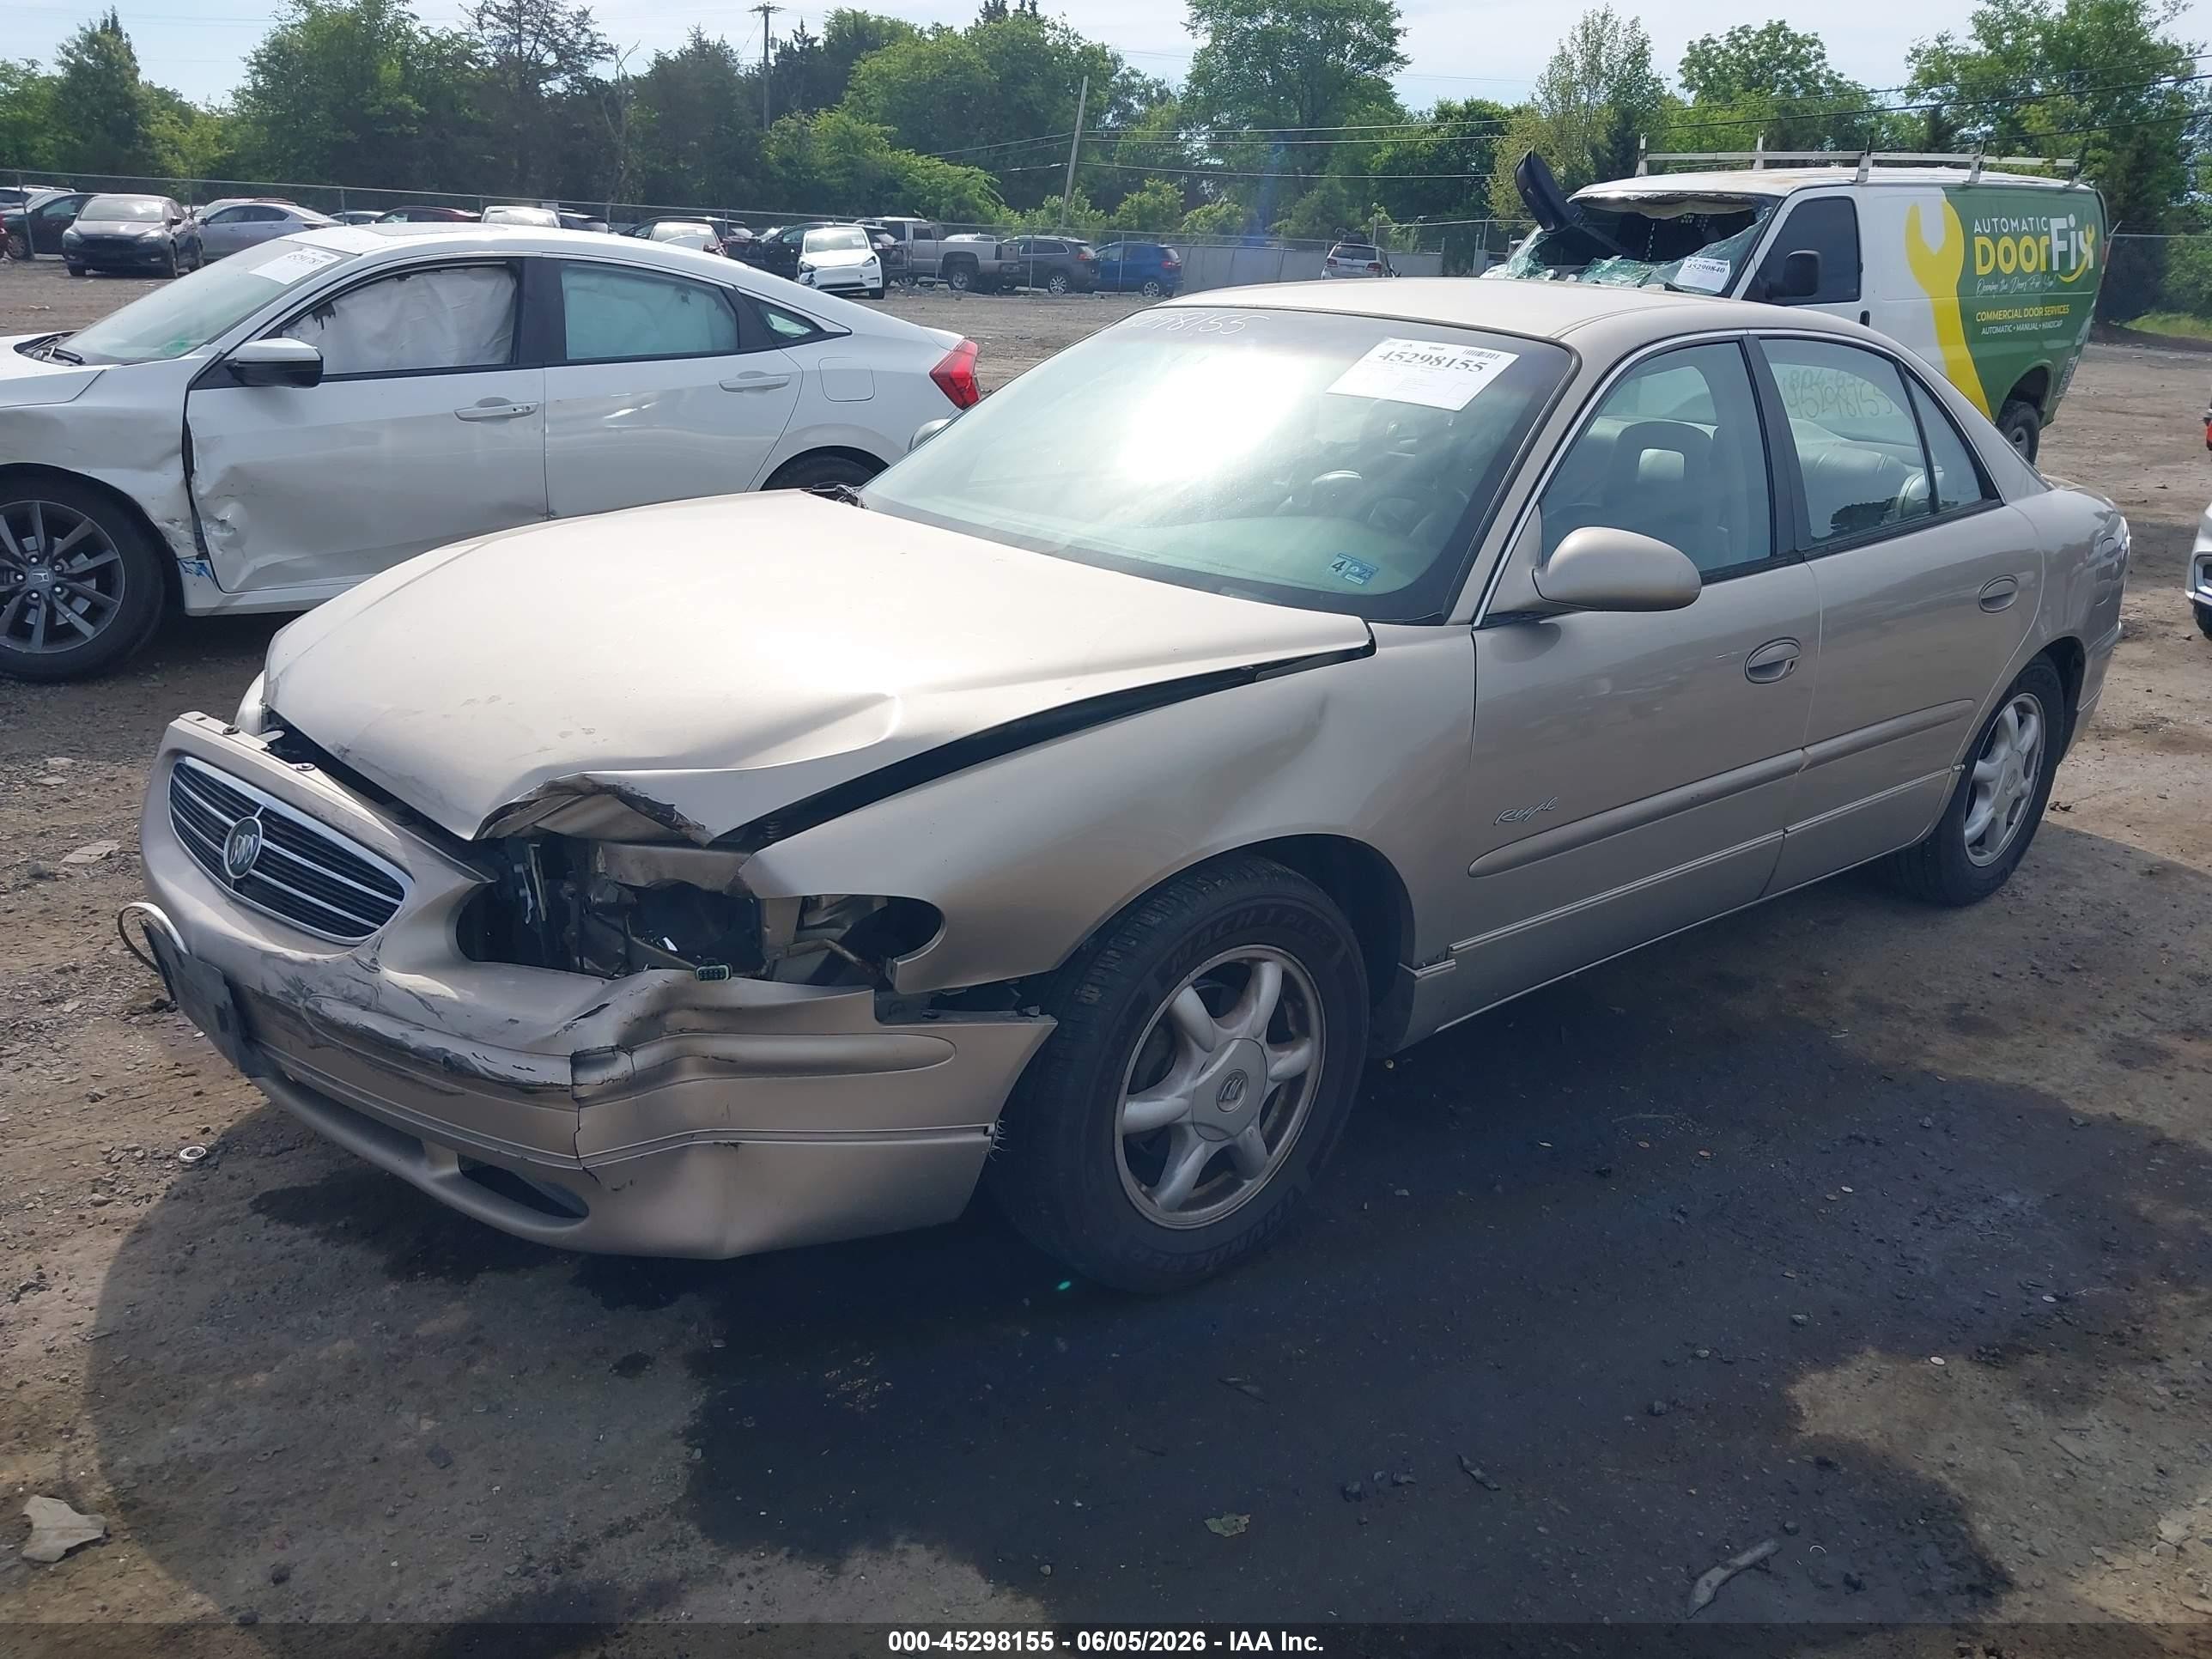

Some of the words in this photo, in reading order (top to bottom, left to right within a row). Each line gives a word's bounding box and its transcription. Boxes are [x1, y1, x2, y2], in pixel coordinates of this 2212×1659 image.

[1973, 216, 2049, 234] AUTOMATIC
[1976, 309, 2022, 322] COMMERCIAL
[2023, 307, 2044, 318] DOOR
[2044, 304, 2070, 317] SERVICES
[1981, 325, 2012, 335] AUTOMATIC
[2016, 322, 2039, 332] MANUAL
[1377, 350, 1489, 373] 45298155
